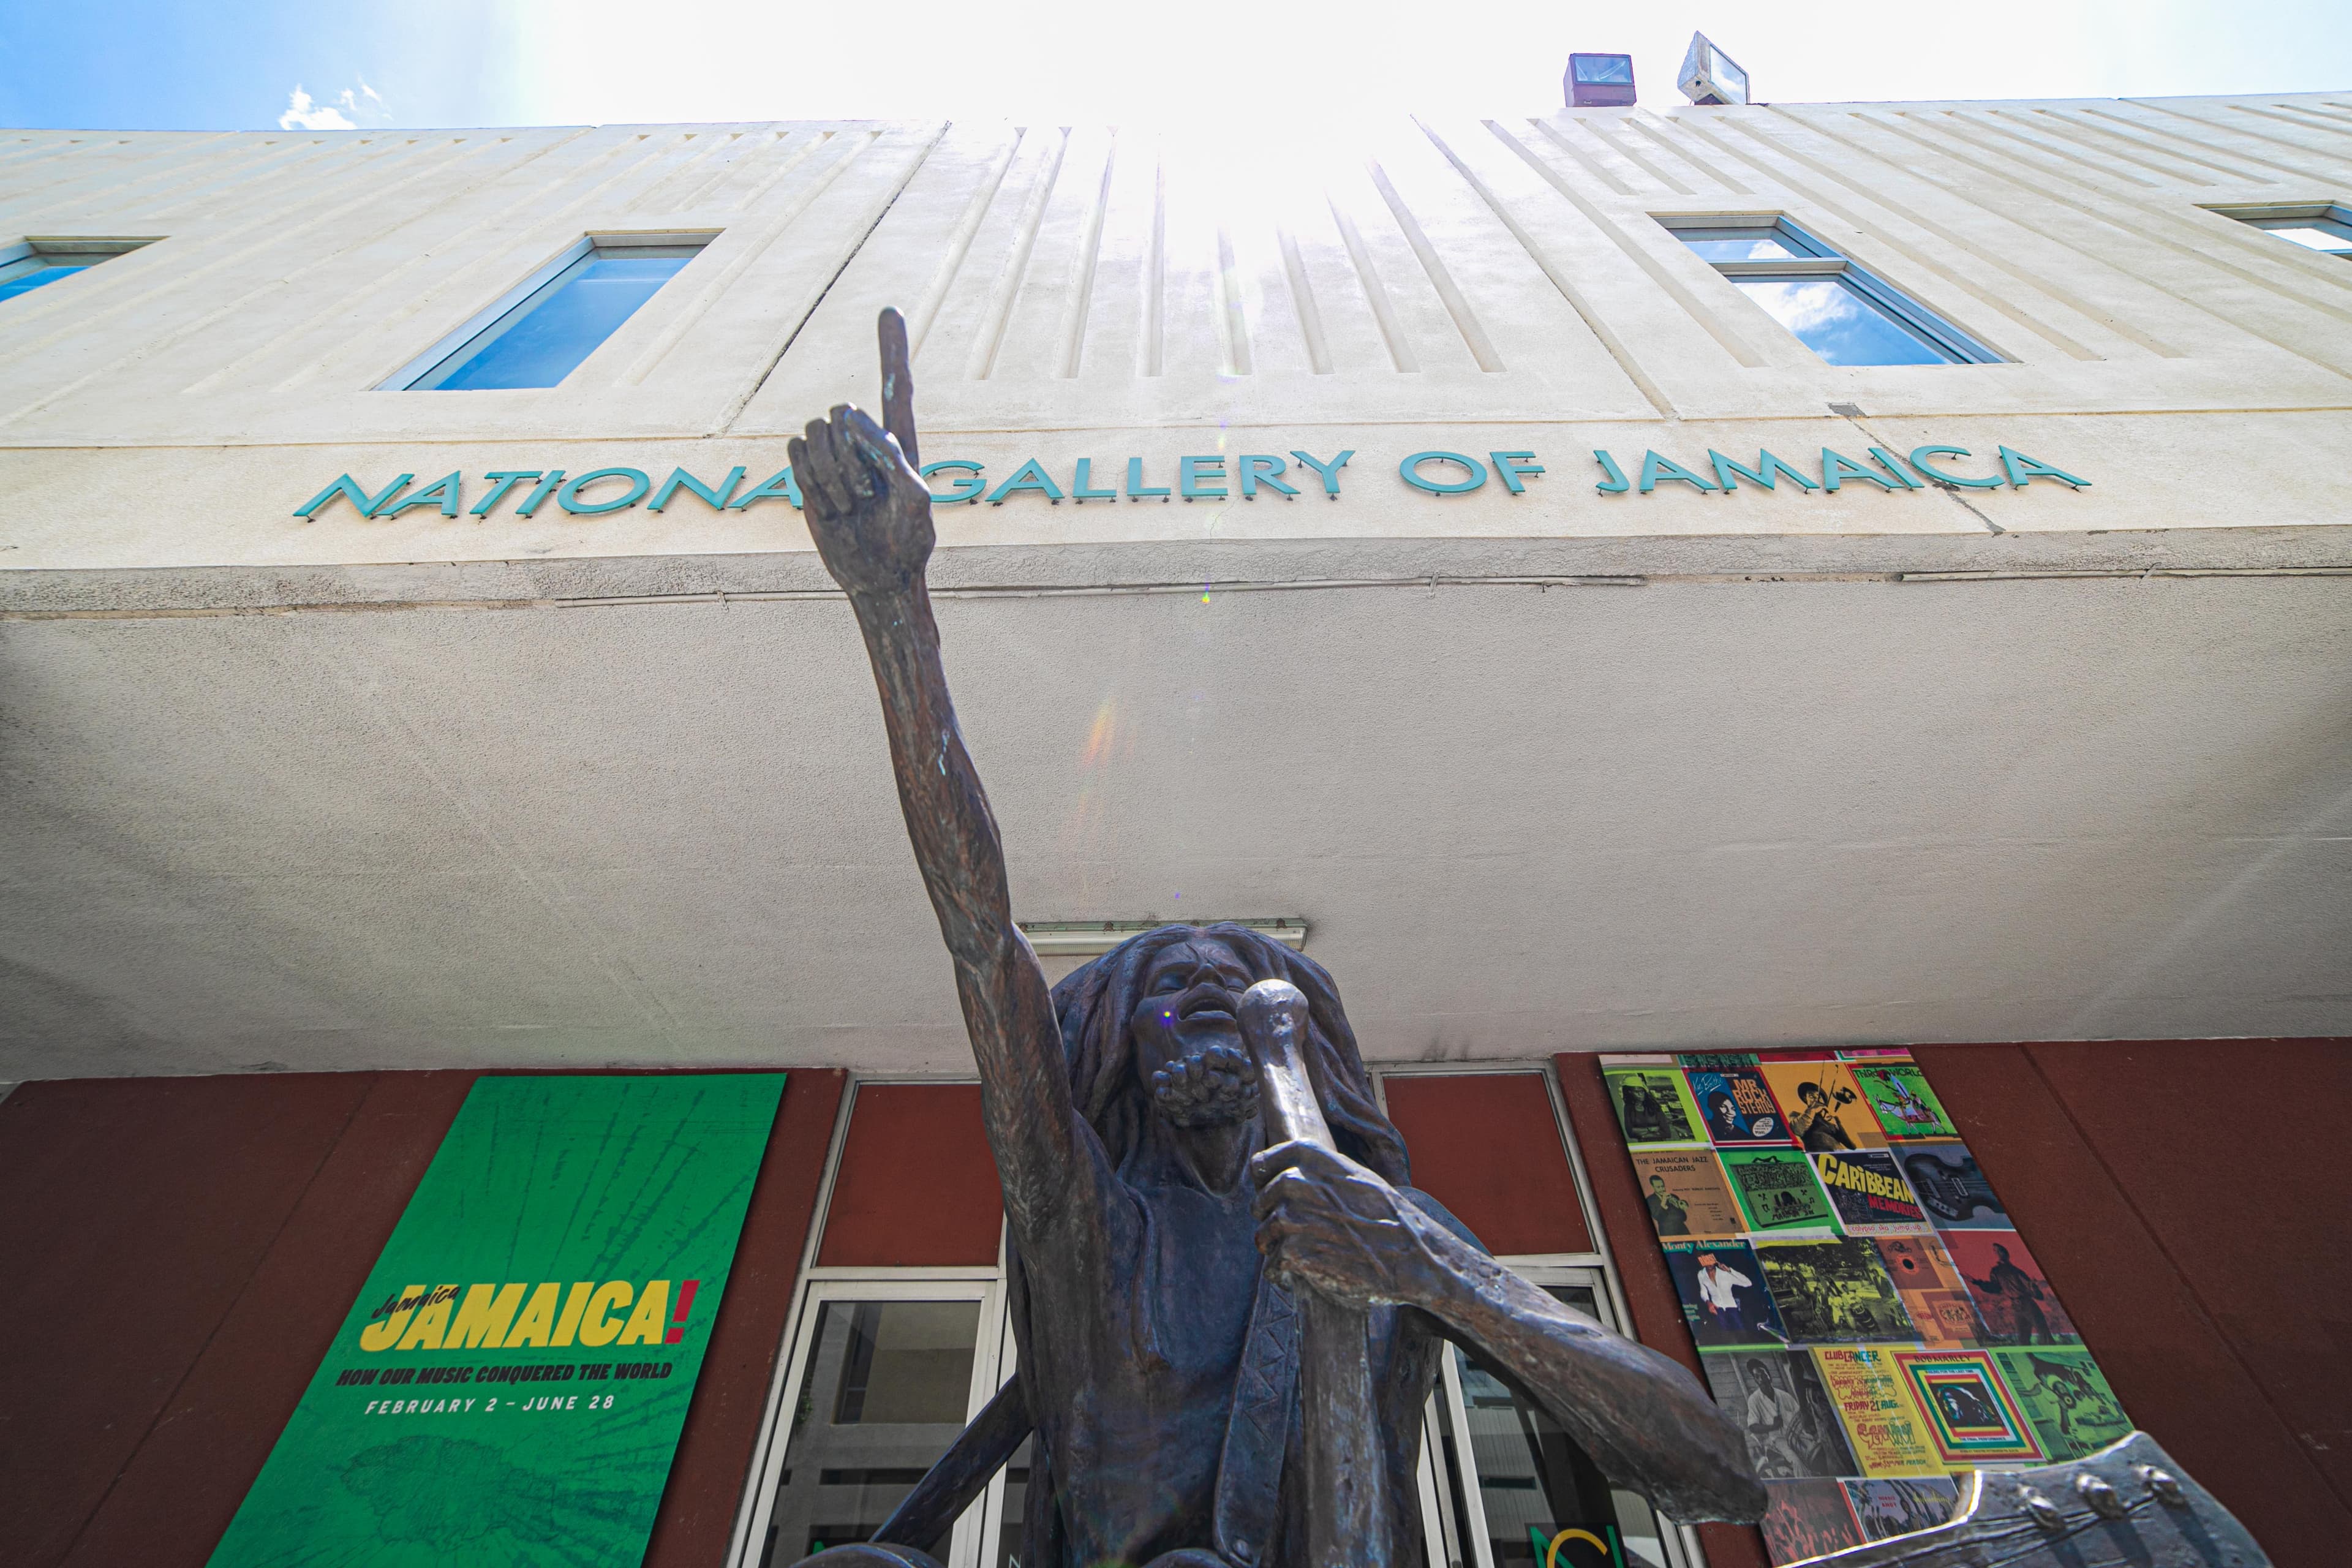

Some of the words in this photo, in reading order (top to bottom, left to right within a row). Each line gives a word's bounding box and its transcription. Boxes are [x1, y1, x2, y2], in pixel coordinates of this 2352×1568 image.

[293, 466, 805, 518] NATIONA
[919, 450, 1355, 503] GALLERY
[1399, 450, 1546, 494] OF
[1593, 445, 2092, 492] JAMAICA
[1732, 1089, 1771, 1103] ROCK
[1740, 1102, 1776, 1114] STEADY
[1868, 1194, 1923, 1219] MEMORIES
[1852, 1225, 1875, 1234] calypso
[1662, 1243, 1692, 1251] Monty
[1696, 1239, 1746, 1250] Alexander
[371, 1285, 461, 1319] Jamaica
[360, 1280, 701, 1351] JAMAICA!
[1825, 1350, 1844, 1360] CLUB
[1844, 1350, 1881, 1362] CANCER
[335, 1369, 379, 1387] HOW
[379, 1367, 416, 1385] OUR
[415, 1365, 472, 1385] MUSIC
[475, 1364, 573, 1385] CONQUERED
[578, 1363, 610, 1381] THE
[614, 1362, 673, 1380] WORLD
[365, 1398, 476, 1415] FEBRUARY
[485, 1398, 498, 1412] 2
[522, 1396, 578, 1411] JUNE
[589, 1395, 614, 1409] 28
[1844, 1401, 1869, 1411] FRIDAY
[1869, 1401, 1880, 1411] 21
